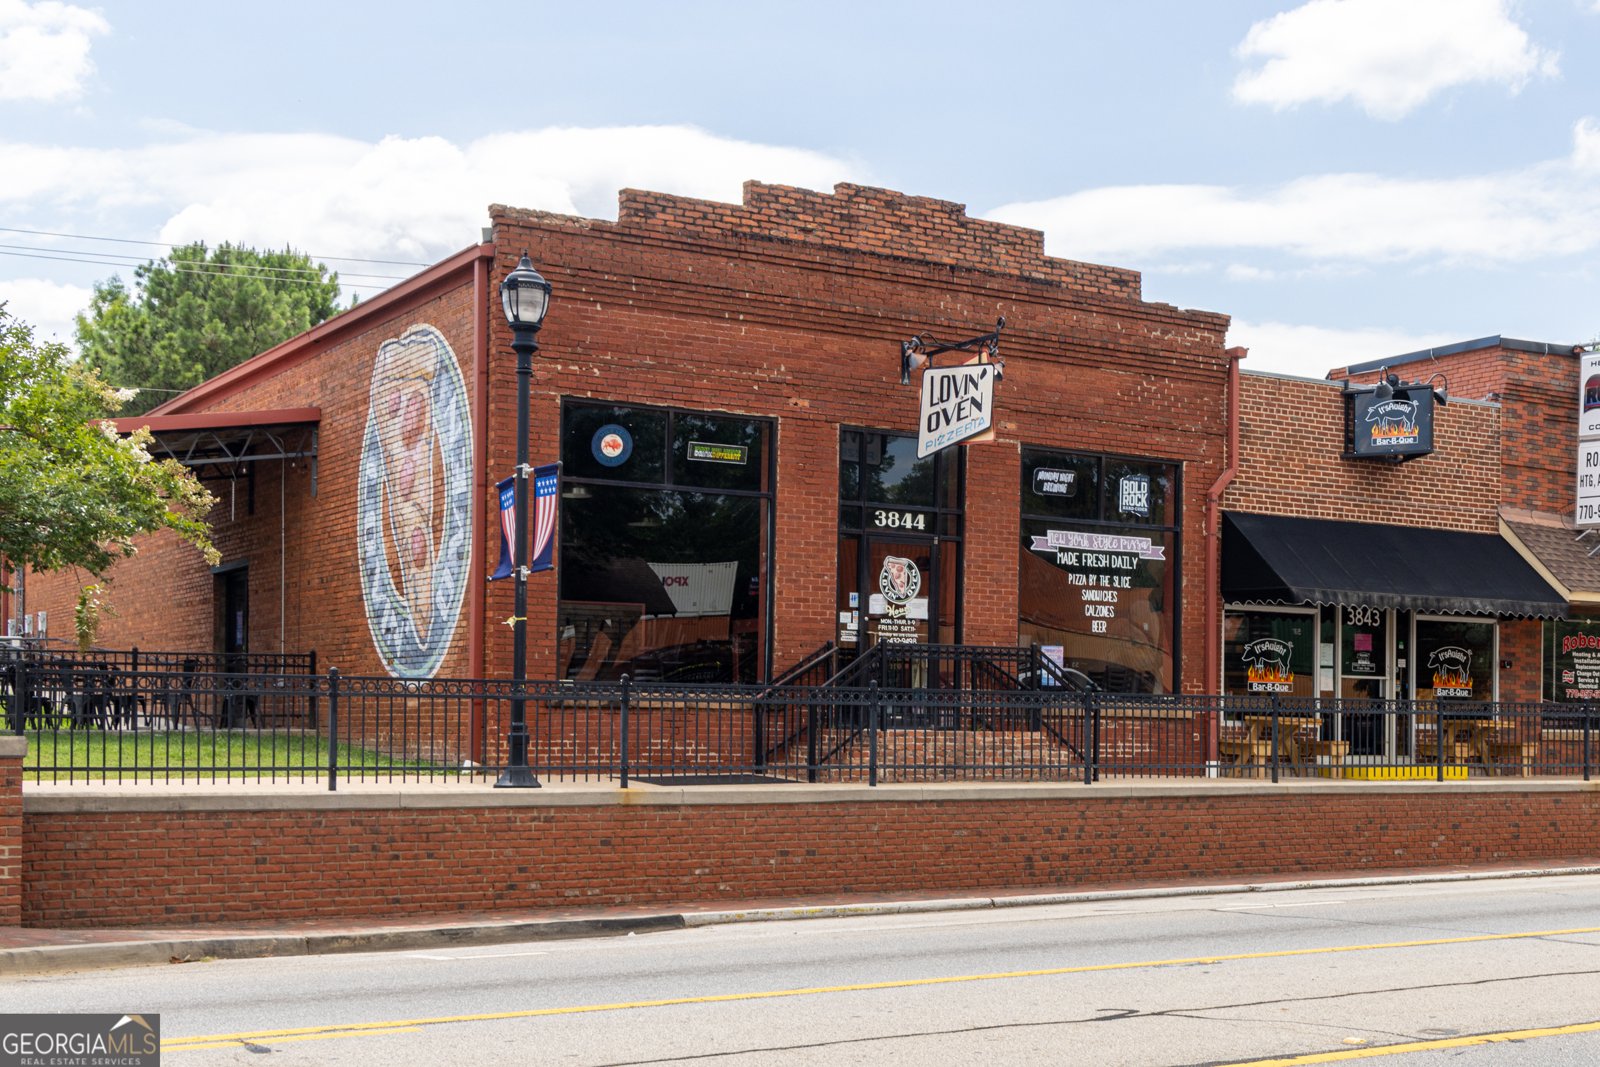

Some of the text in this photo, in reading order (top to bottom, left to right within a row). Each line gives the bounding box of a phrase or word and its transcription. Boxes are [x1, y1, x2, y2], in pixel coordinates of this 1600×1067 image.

[930, 367, 987, 407] LOVIN'
[927, 392, 983, 433] OVEN
[925, 416, 985, 451] PIZZERIA
[1376, 437, 1414, 445] Bar-B-Que
[1586, 452, 1600, 467] RO
[1123, 480, 1148, 494] BOLD
[1123, 493, 1148, 507] ROCK
[874, 510, 926, 530] 3844
[1057, 551, 1138, 570] MADE FRESH DAILY
[1068, 573, 1131, 588] PIZZA BY THE SLICE
[1081, 589, 1118, 602] SANDWICHES
[1085, 604, 1115, 618] CALZONES
[1347, 608, 1381, 627] 3843
[1091, 620, 1107, 633] BEER
[1252, 682, 1289, 692] Bar-B-Que
[1437, 688, 1469, 696] Bar-B-Que
